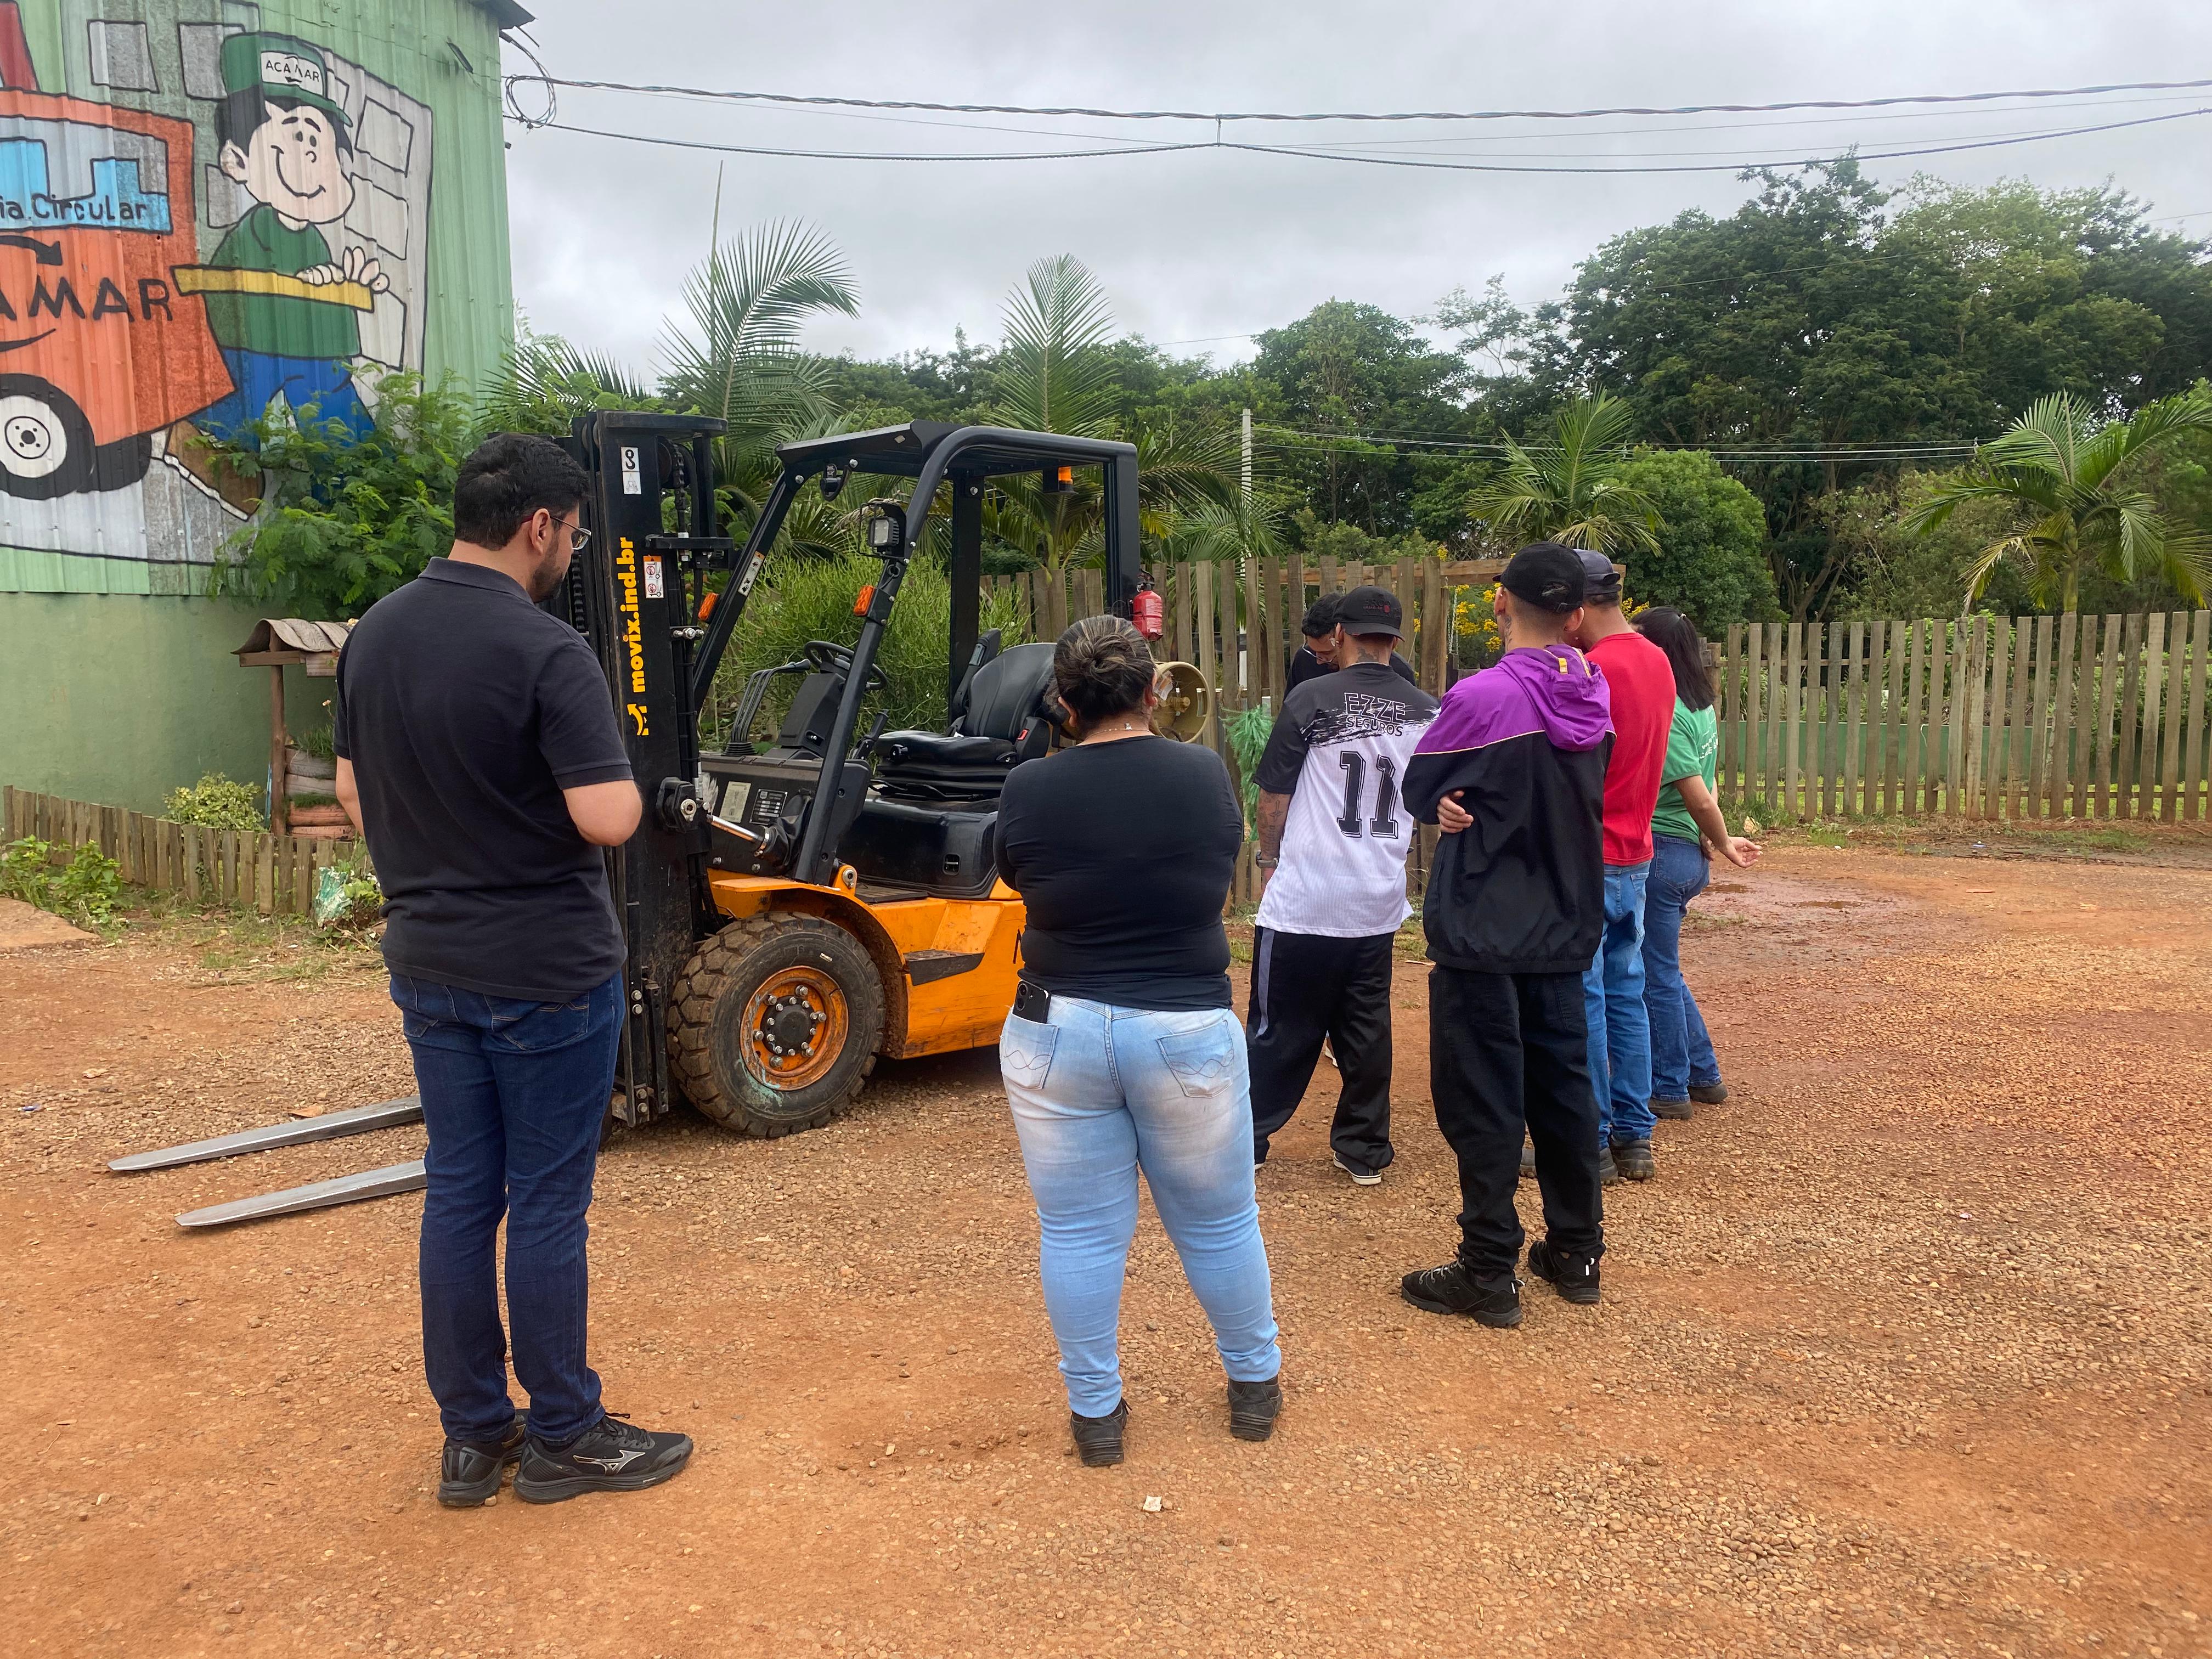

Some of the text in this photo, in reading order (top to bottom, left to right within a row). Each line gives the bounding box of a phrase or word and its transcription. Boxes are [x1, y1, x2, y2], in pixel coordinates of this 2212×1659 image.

[32, 193, 147, 219] Circular
[616, 537, 646, 693] movix.ind.br
[1344, 692, 1406, 724] EZZE
[1346, 716, 1403, 737] SEGUROS
[1336, 751, 1398, 839] 11
